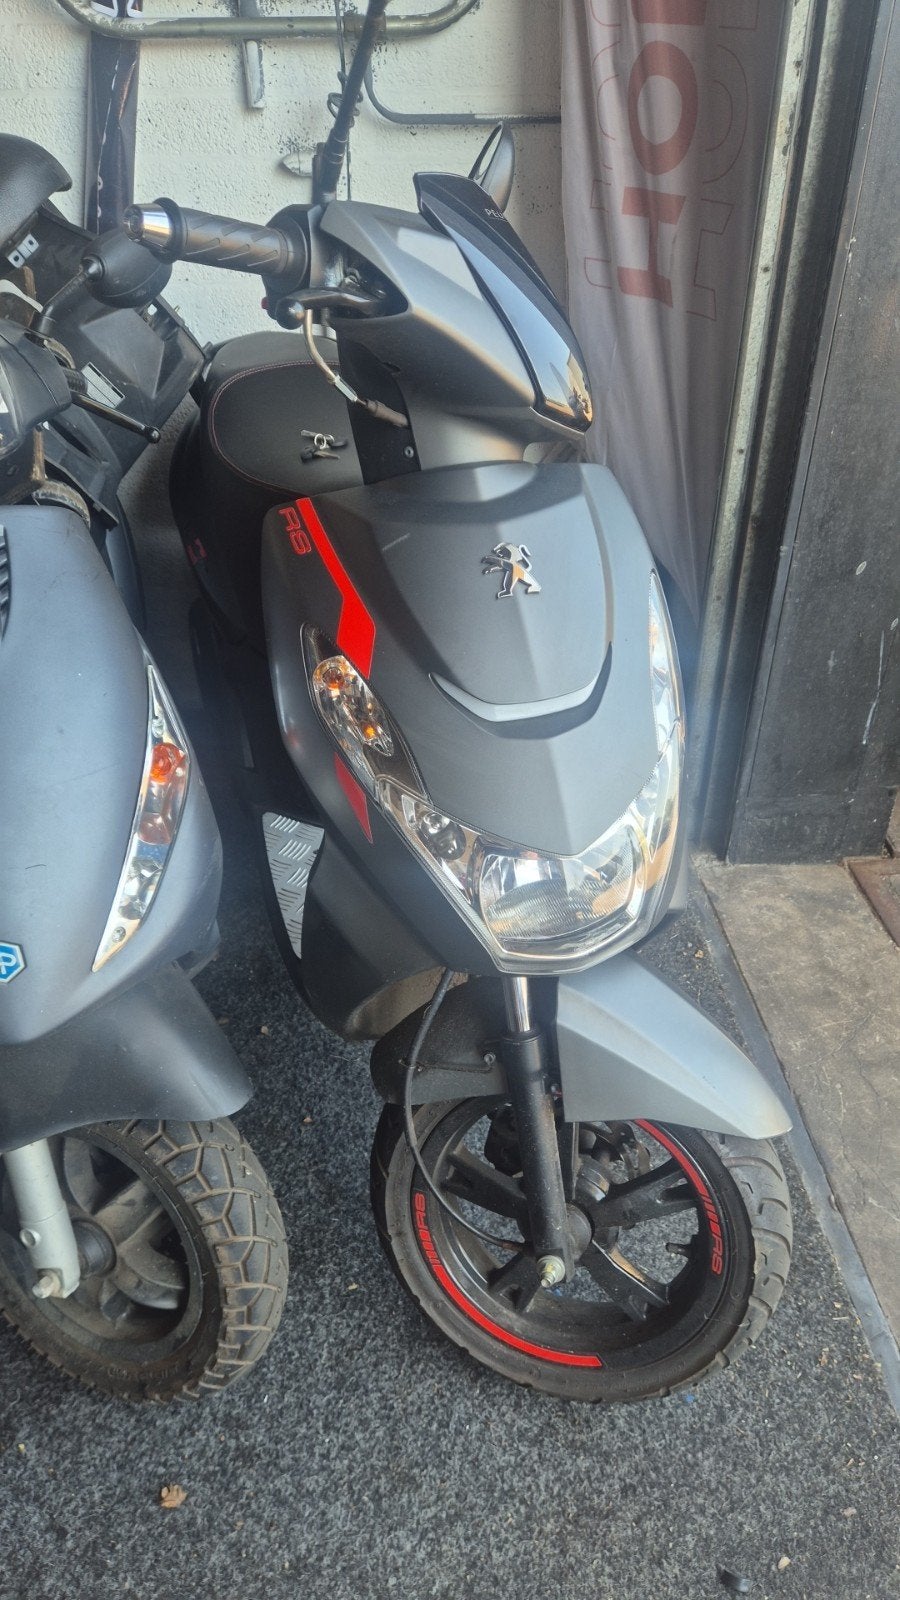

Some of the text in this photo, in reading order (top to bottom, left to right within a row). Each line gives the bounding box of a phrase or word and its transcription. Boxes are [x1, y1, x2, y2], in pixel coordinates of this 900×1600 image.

[617, 0, 706, 308] HO
[278, 506, 312, 556] RS
[414, 1192, 429, 1230] RS
[711, 1237, 724, 1275] RS
